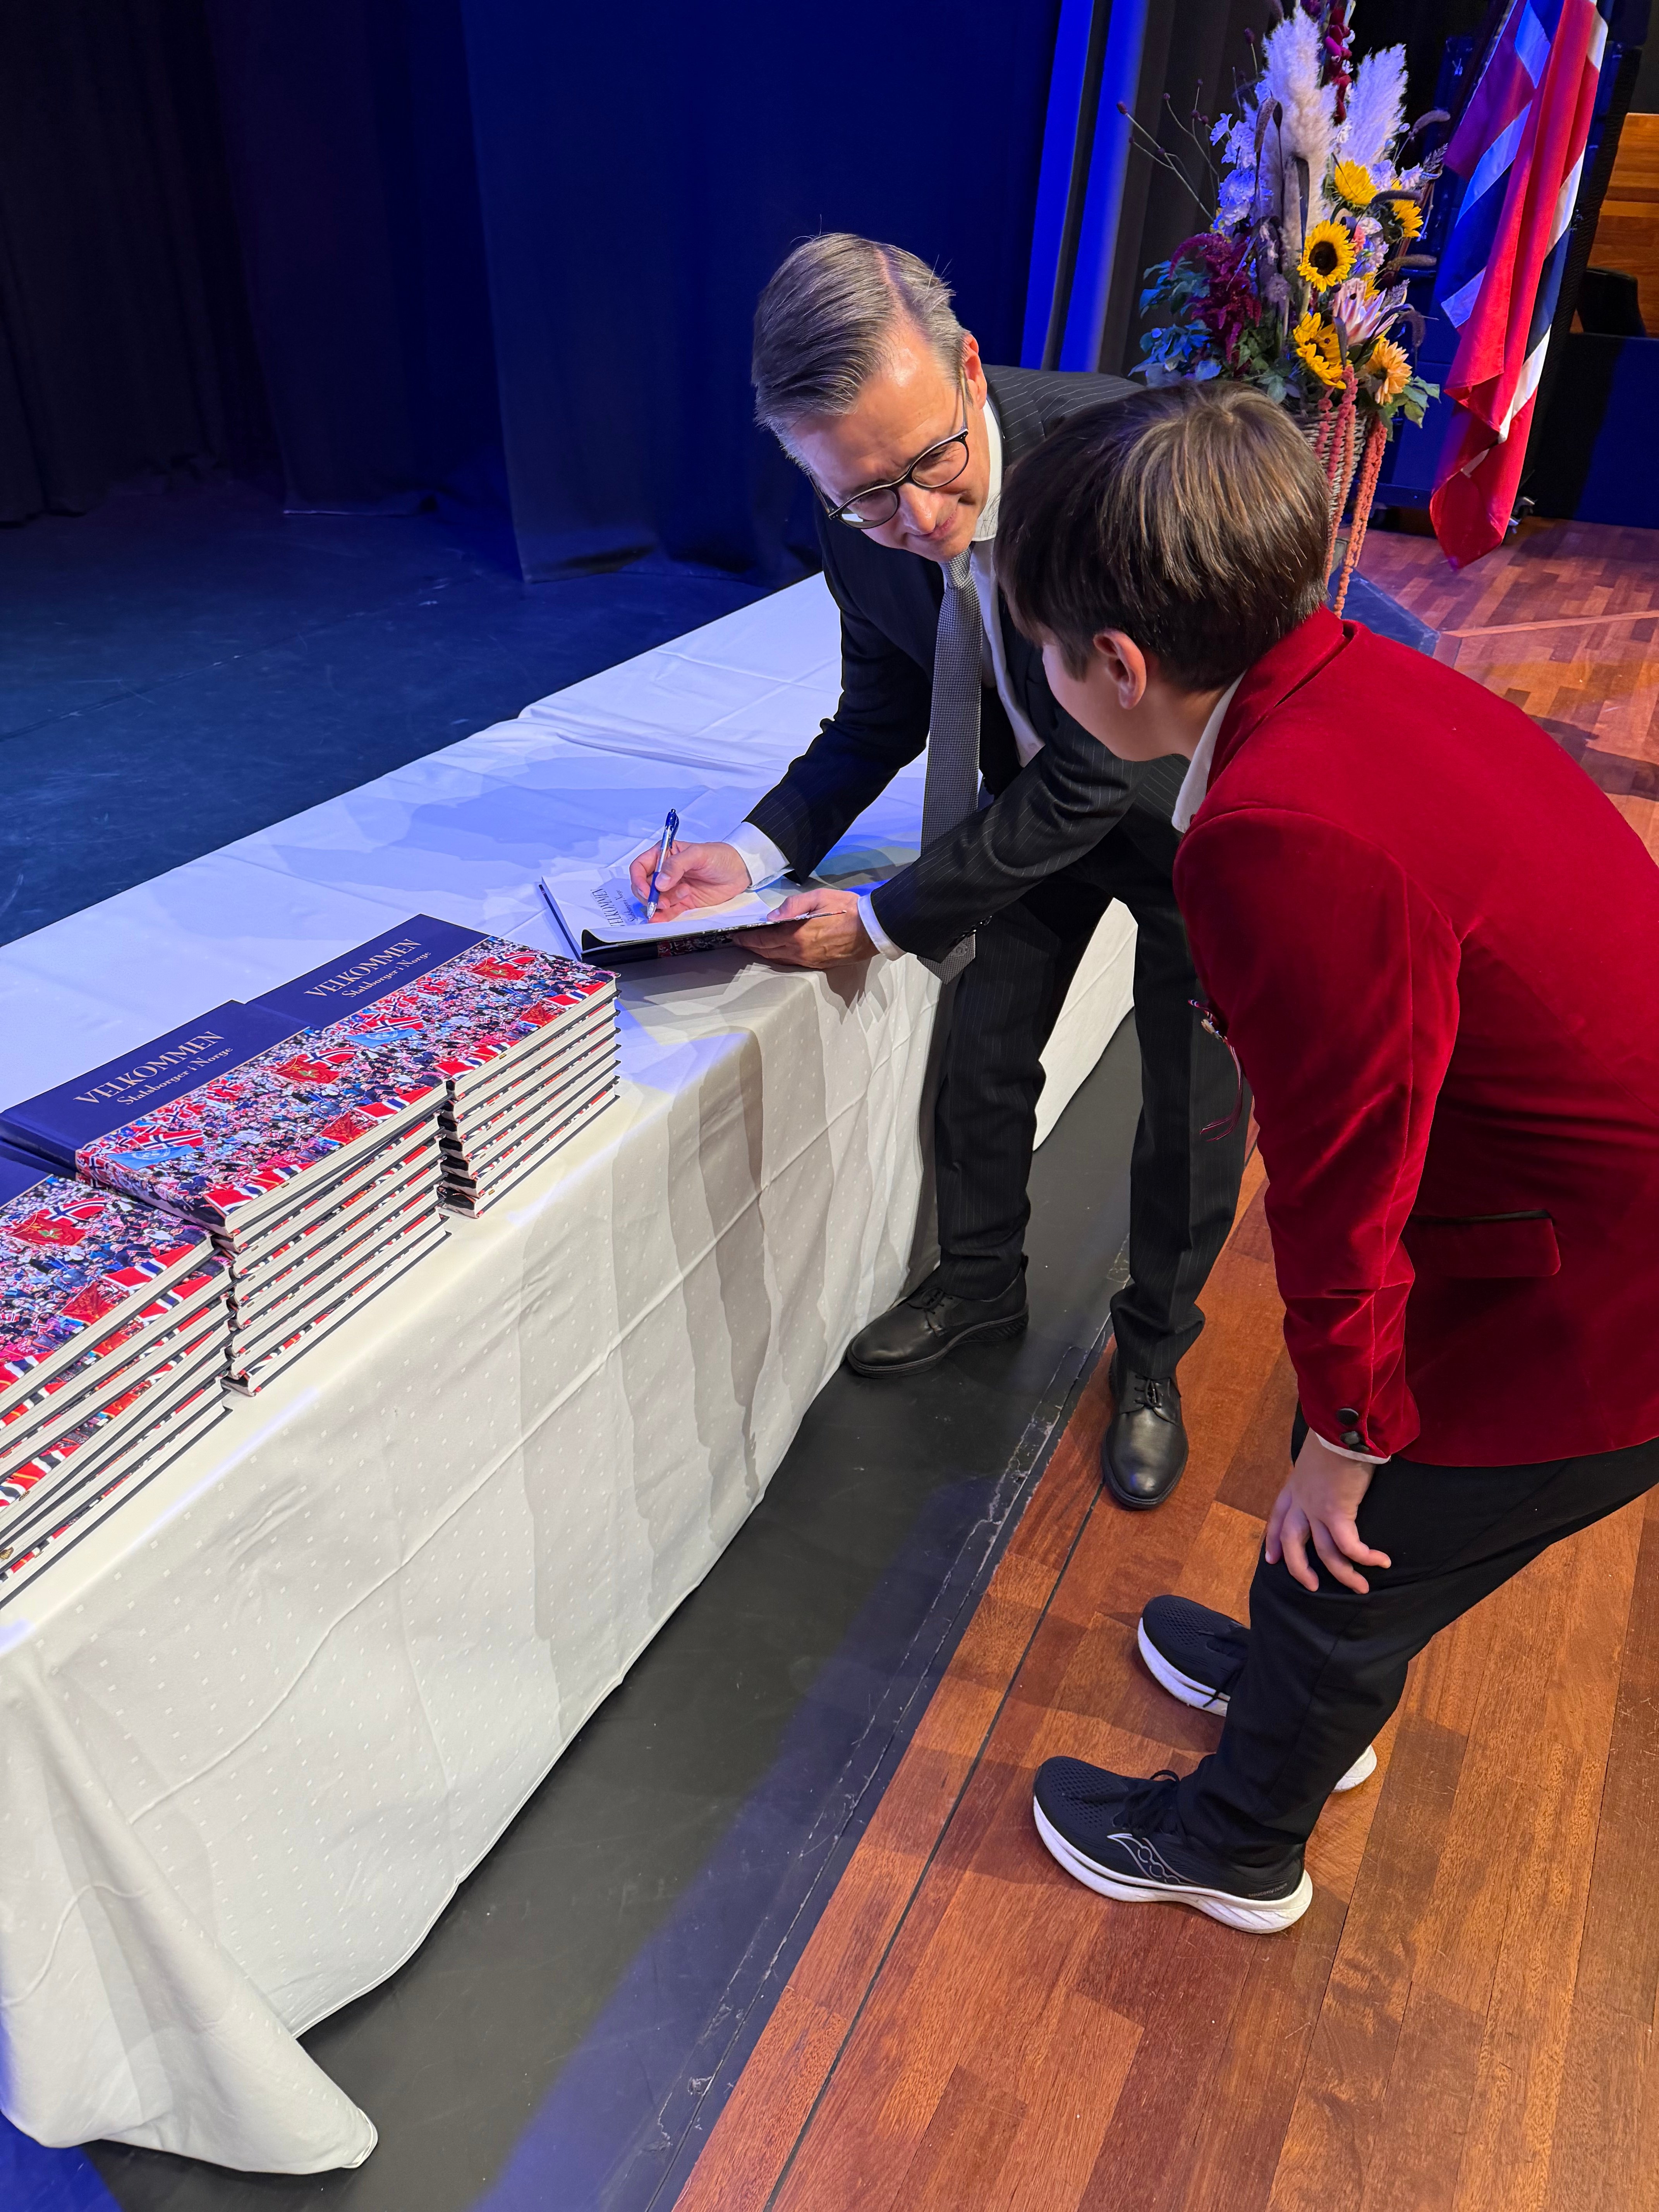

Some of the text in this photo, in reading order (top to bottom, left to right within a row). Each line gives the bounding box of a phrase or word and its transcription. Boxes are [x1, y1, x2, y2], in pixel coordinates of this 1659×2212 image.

[304, 939, 422, 996] VELKOMMEN
[342, 969, 398, 998] Statsborger
[397, 952, 431, 968] Norge
[73, 1031, 225, 1103] VELKOMMEN
[117, 1070, 190, 1105] Statsborger
[190, 1048, 233, 1067] Norge
[1248, 1889, 1274, 1897] saucony
